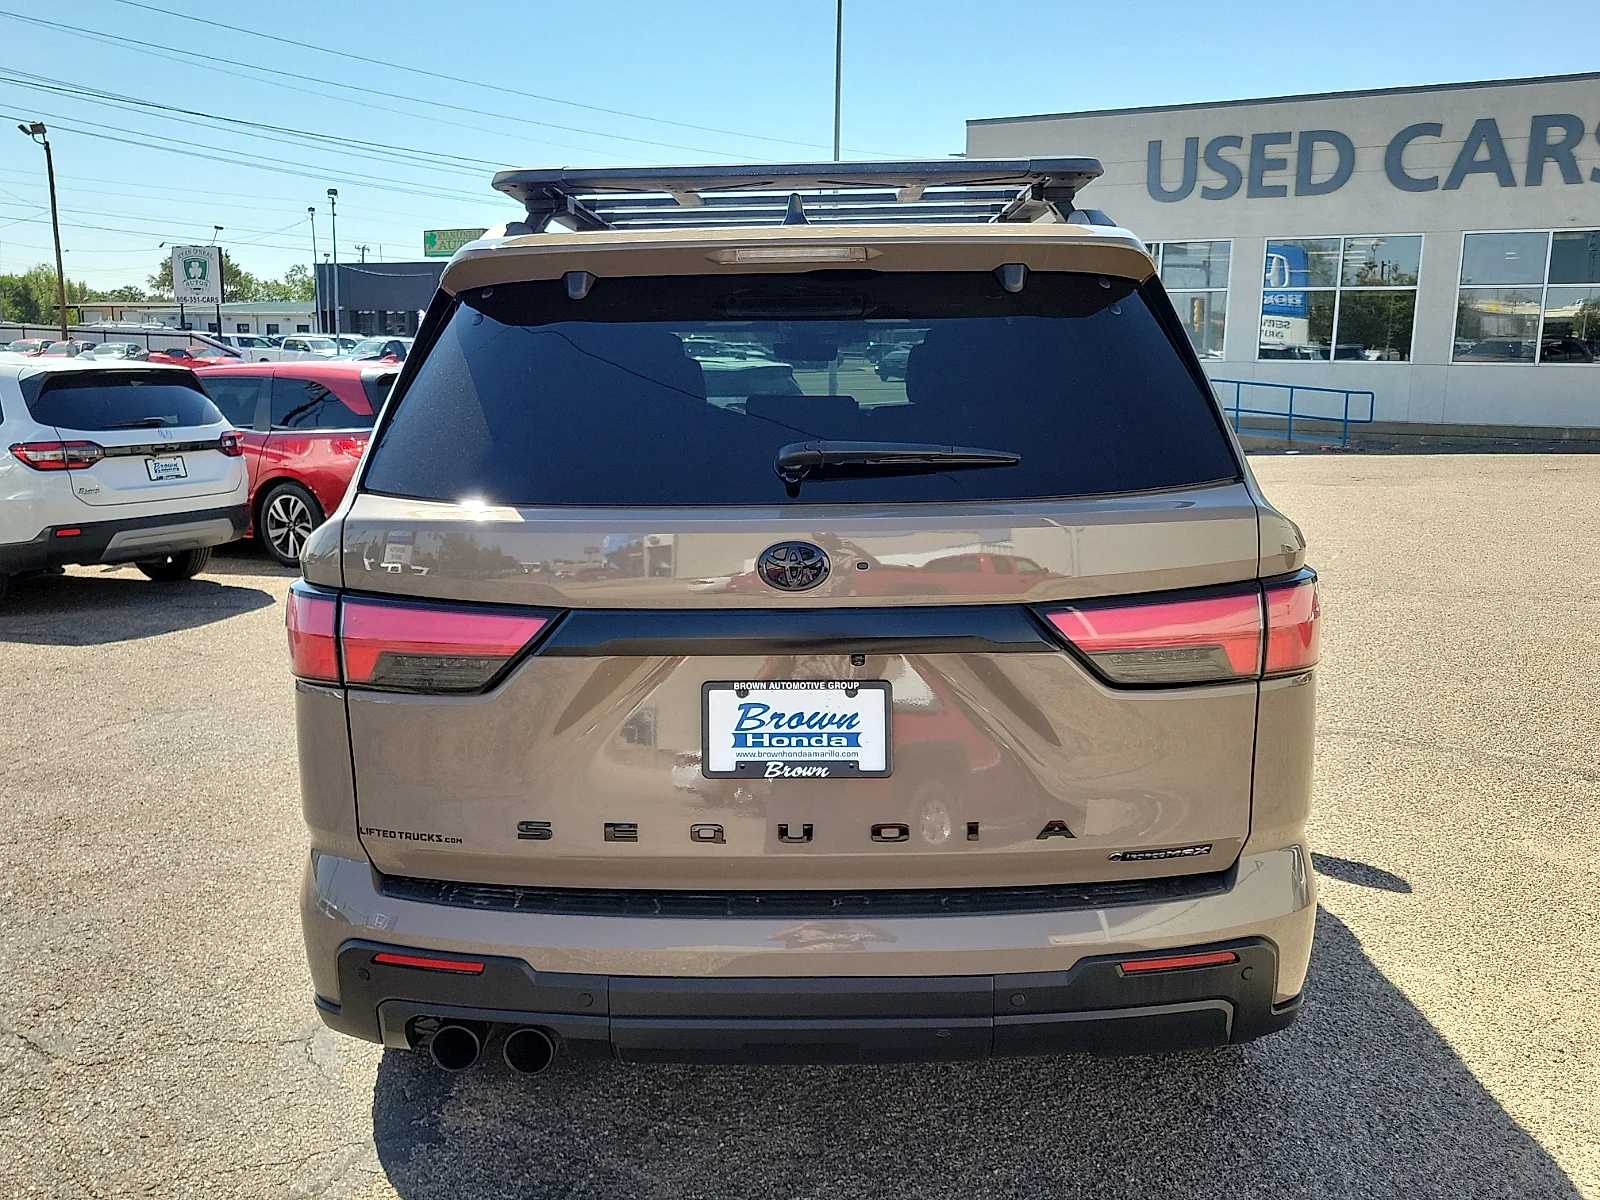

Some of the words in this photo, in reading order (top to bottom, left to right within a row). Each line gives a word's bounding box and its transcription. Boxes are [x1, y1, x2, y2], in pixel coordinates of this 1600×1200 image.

[1146, 129, 1356, 203] USED
[1384, 112, 1600, 193] CAR
[733, 682, 766, 690] BROWN
[769, 682, 825, 690] AUTOMOTIVE
[828, 682, 860, 690] GROUP
[734, 702, 861, 732] Brown
[746, 733, 848, 748] Honda
[735, 750, 859, 759] www.brownhondaamarillo.com
[764, 761, 830, 778] Brown
[517, 819, 1078, 845] SEQUOIA
